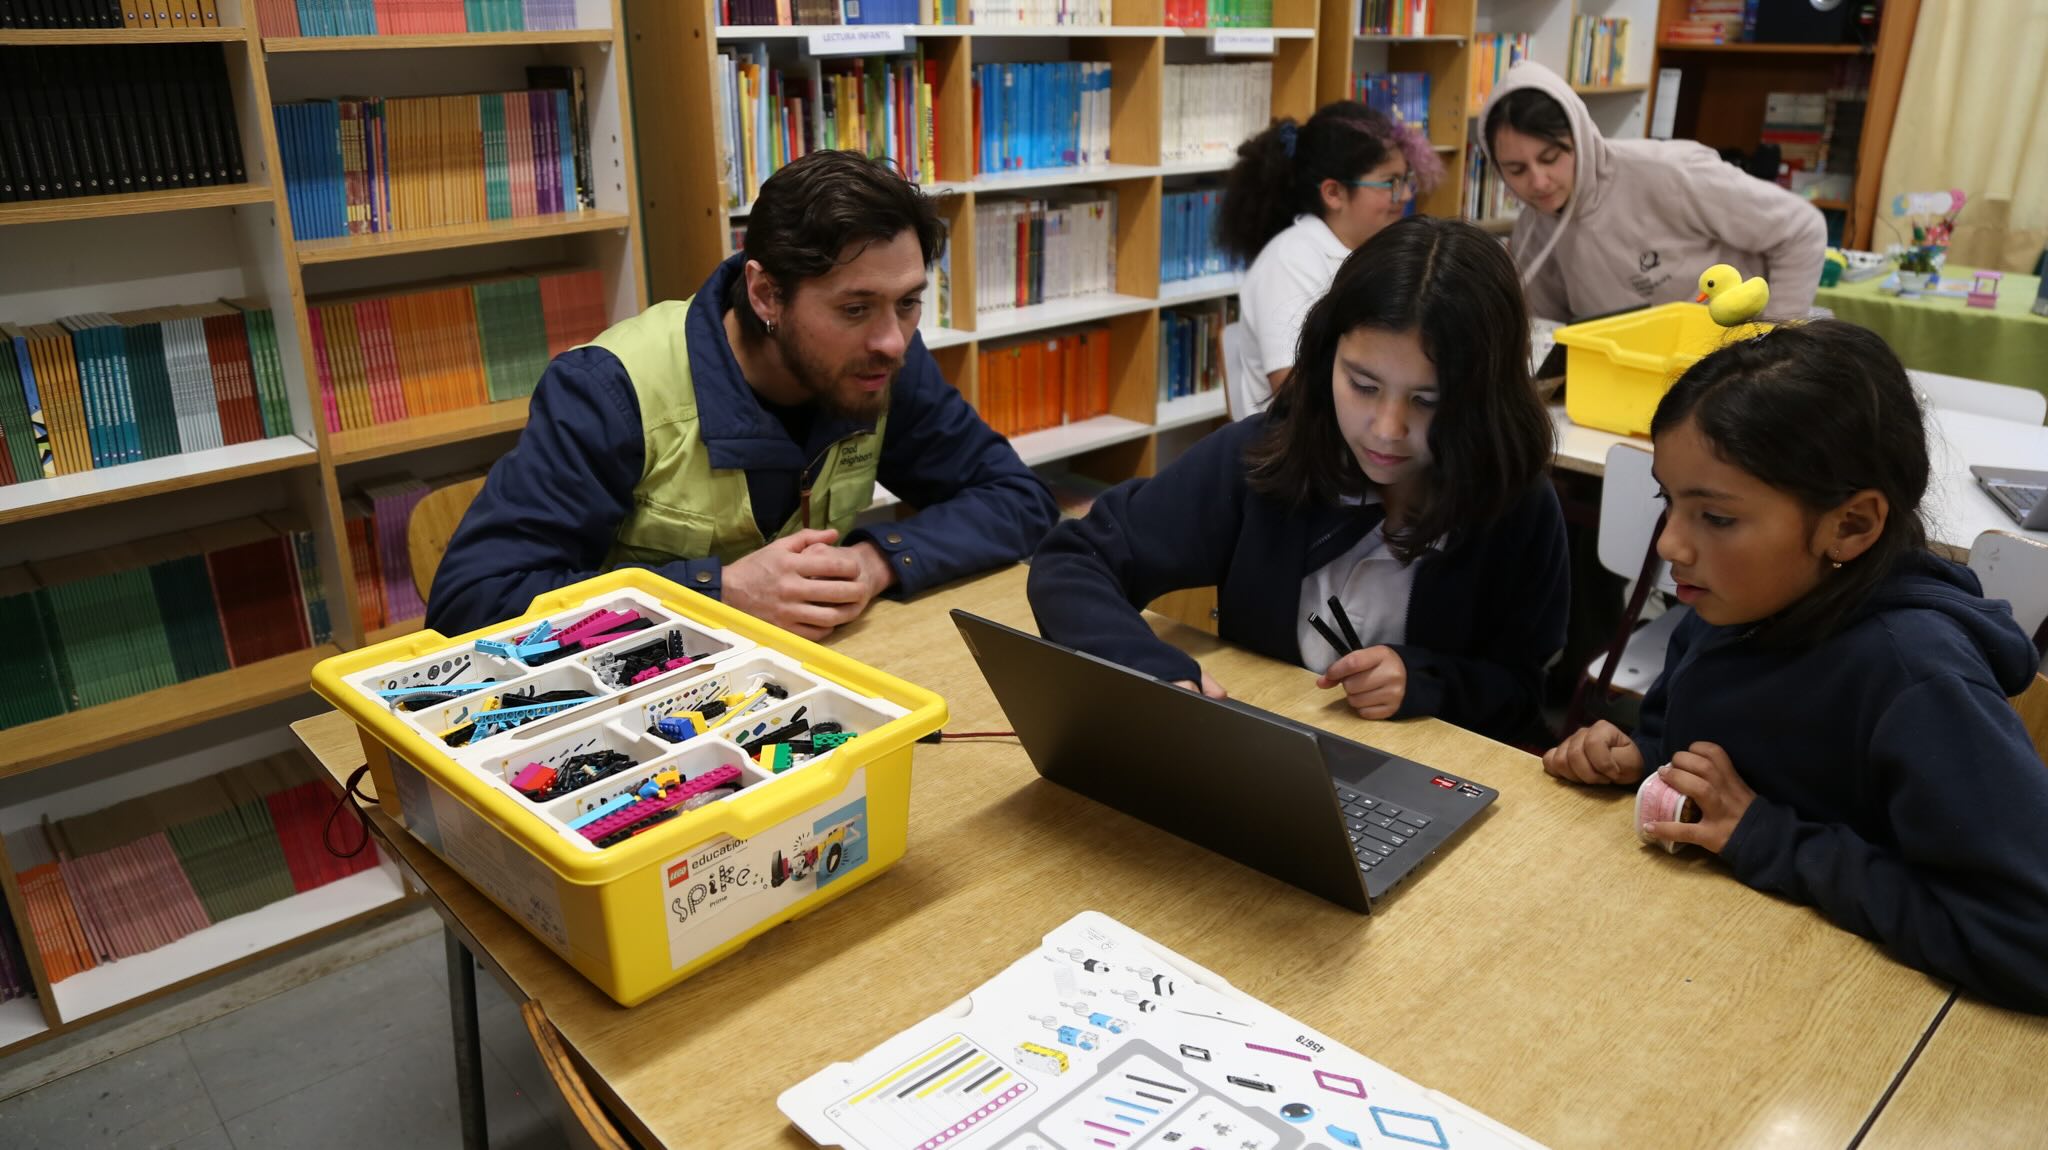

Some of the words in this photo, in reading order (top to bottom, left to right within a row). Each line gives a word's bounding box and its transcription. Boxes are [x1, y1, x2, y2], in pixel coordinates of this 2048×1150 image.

[823, 32, 856, 42] LECTURA
[858, 31, 891, 41] INFANTIL
[1296, 1035, 1325, 1053] 45678
